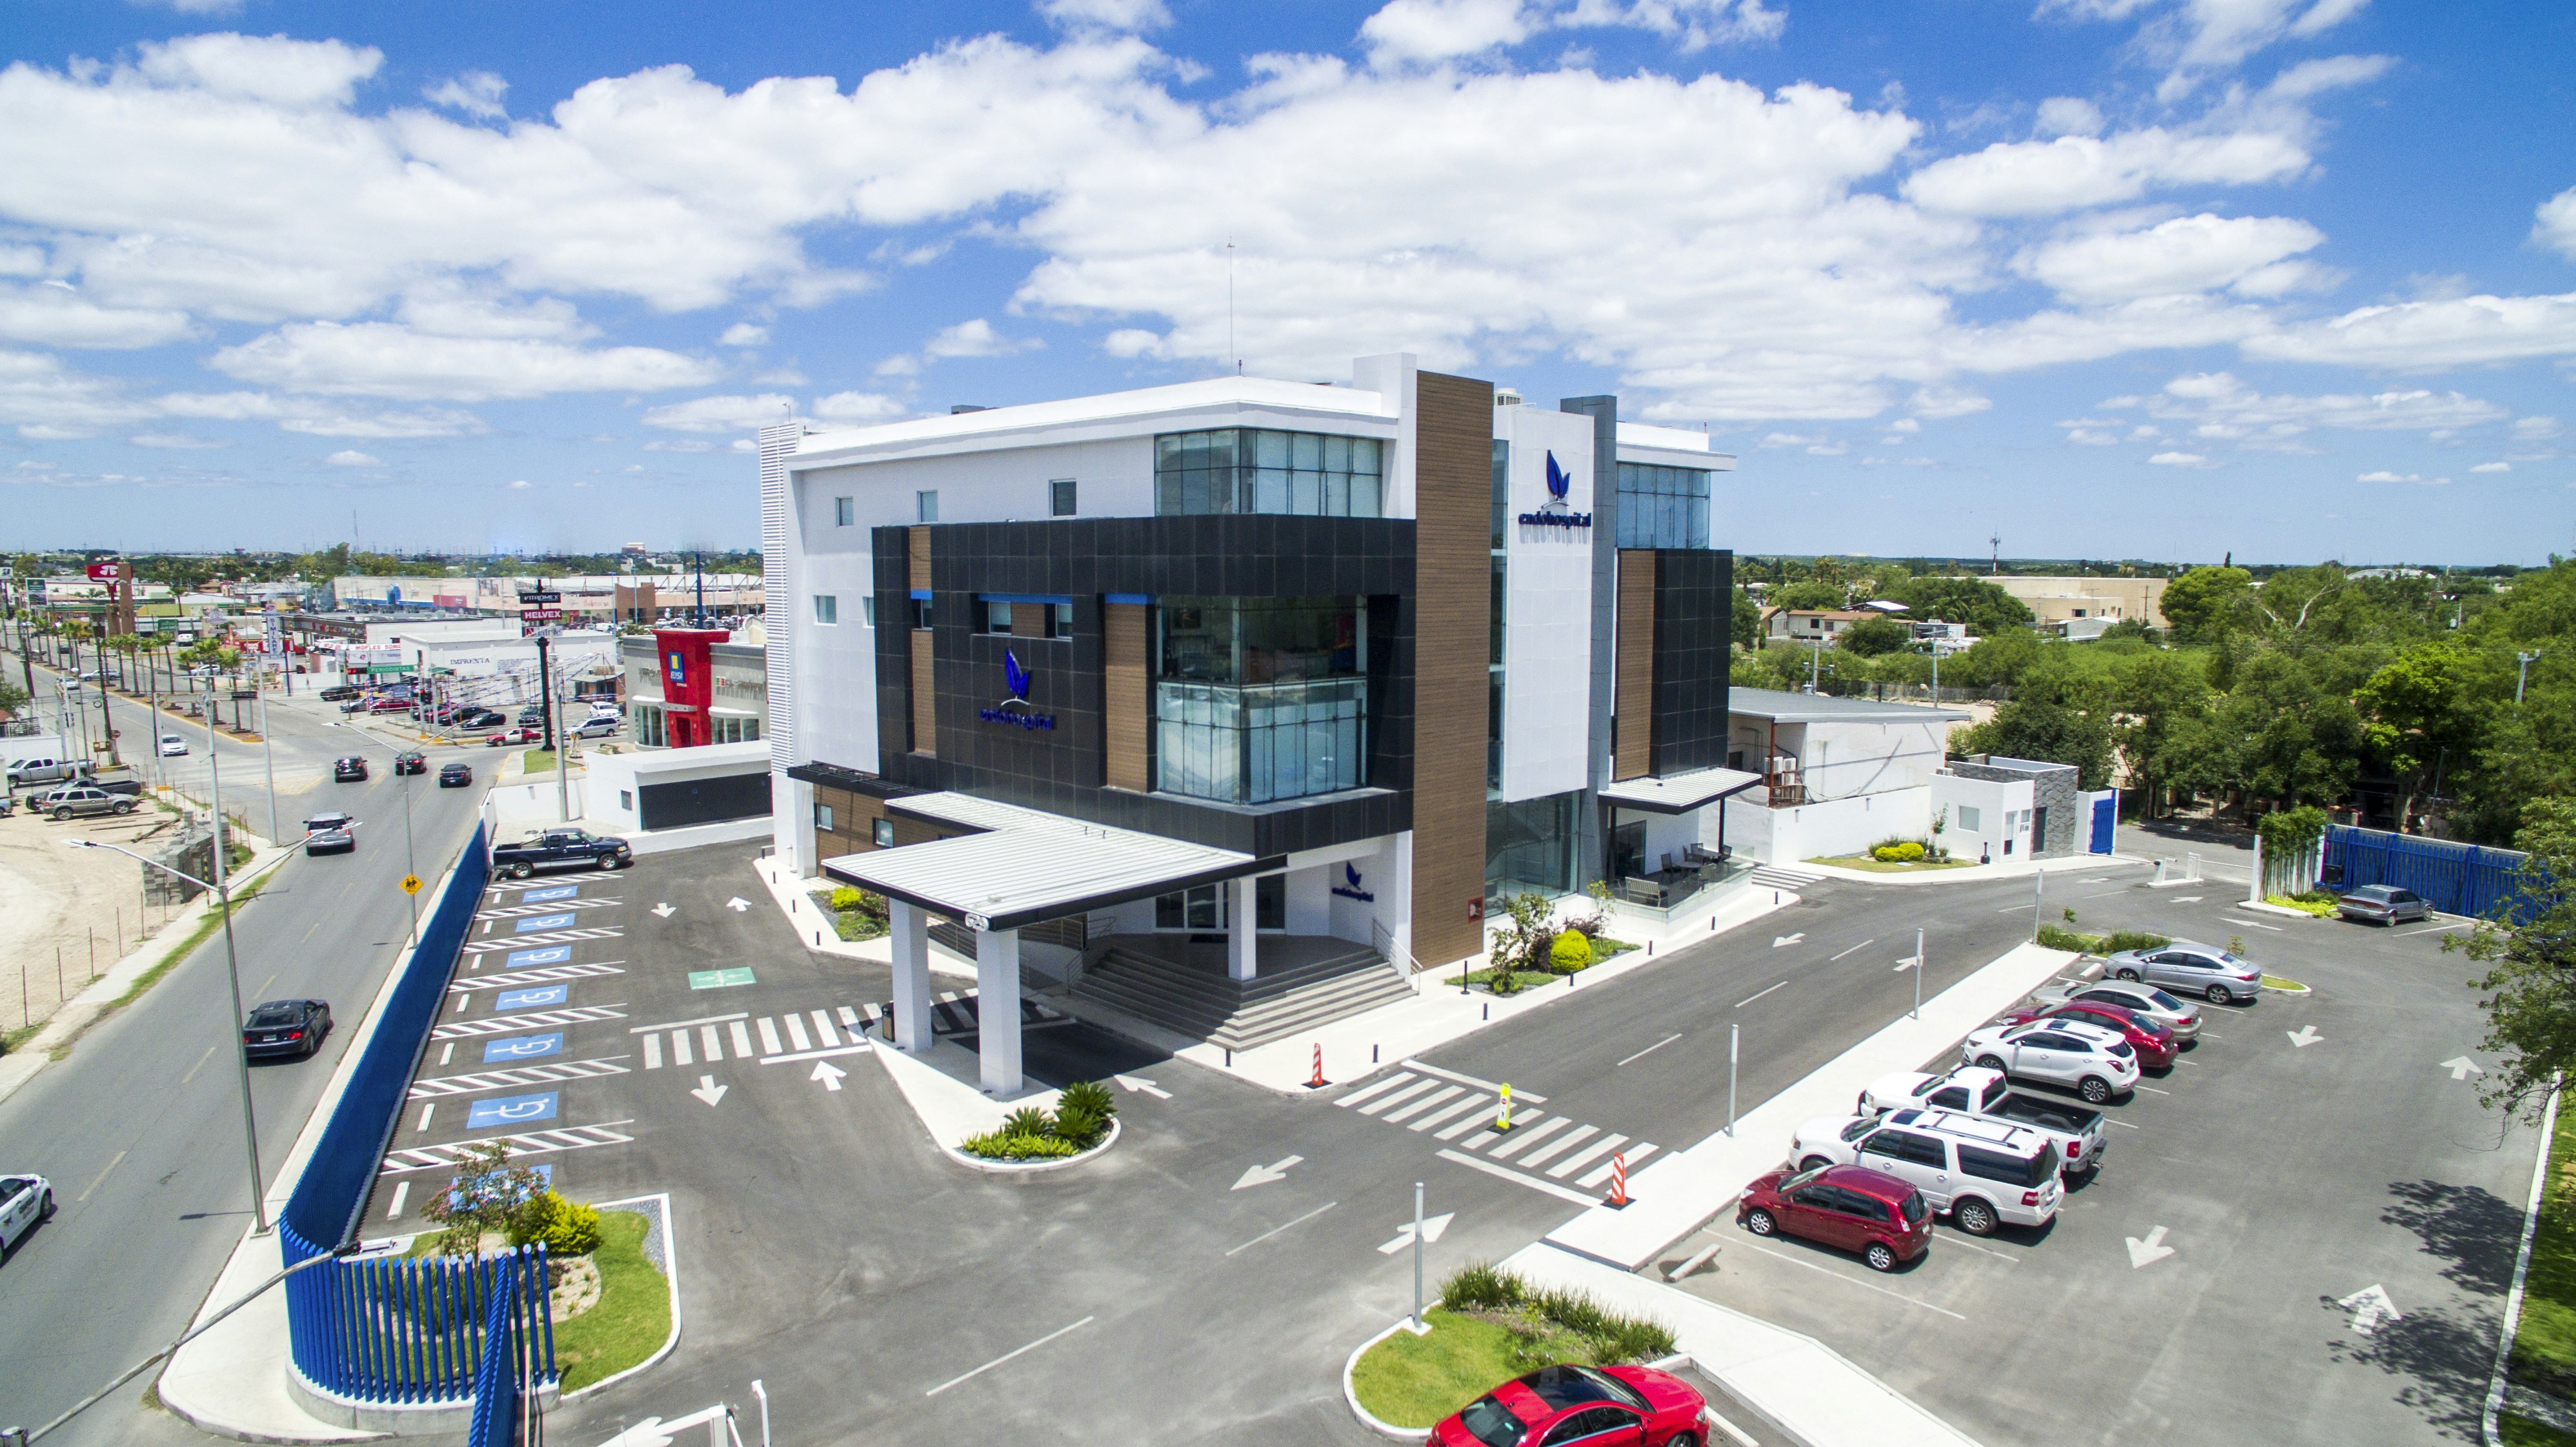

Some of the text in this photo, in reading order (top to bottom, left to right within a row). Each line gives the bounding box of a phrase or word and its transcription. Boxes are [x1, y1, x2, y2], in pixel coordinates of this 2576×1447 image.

[1518, 511, 1591, 530] endohospital
[525, 611, 561, 619] HELVEX
[980, 709, 1054, 731] endohospital
[965, 913, 989, 932] 629
